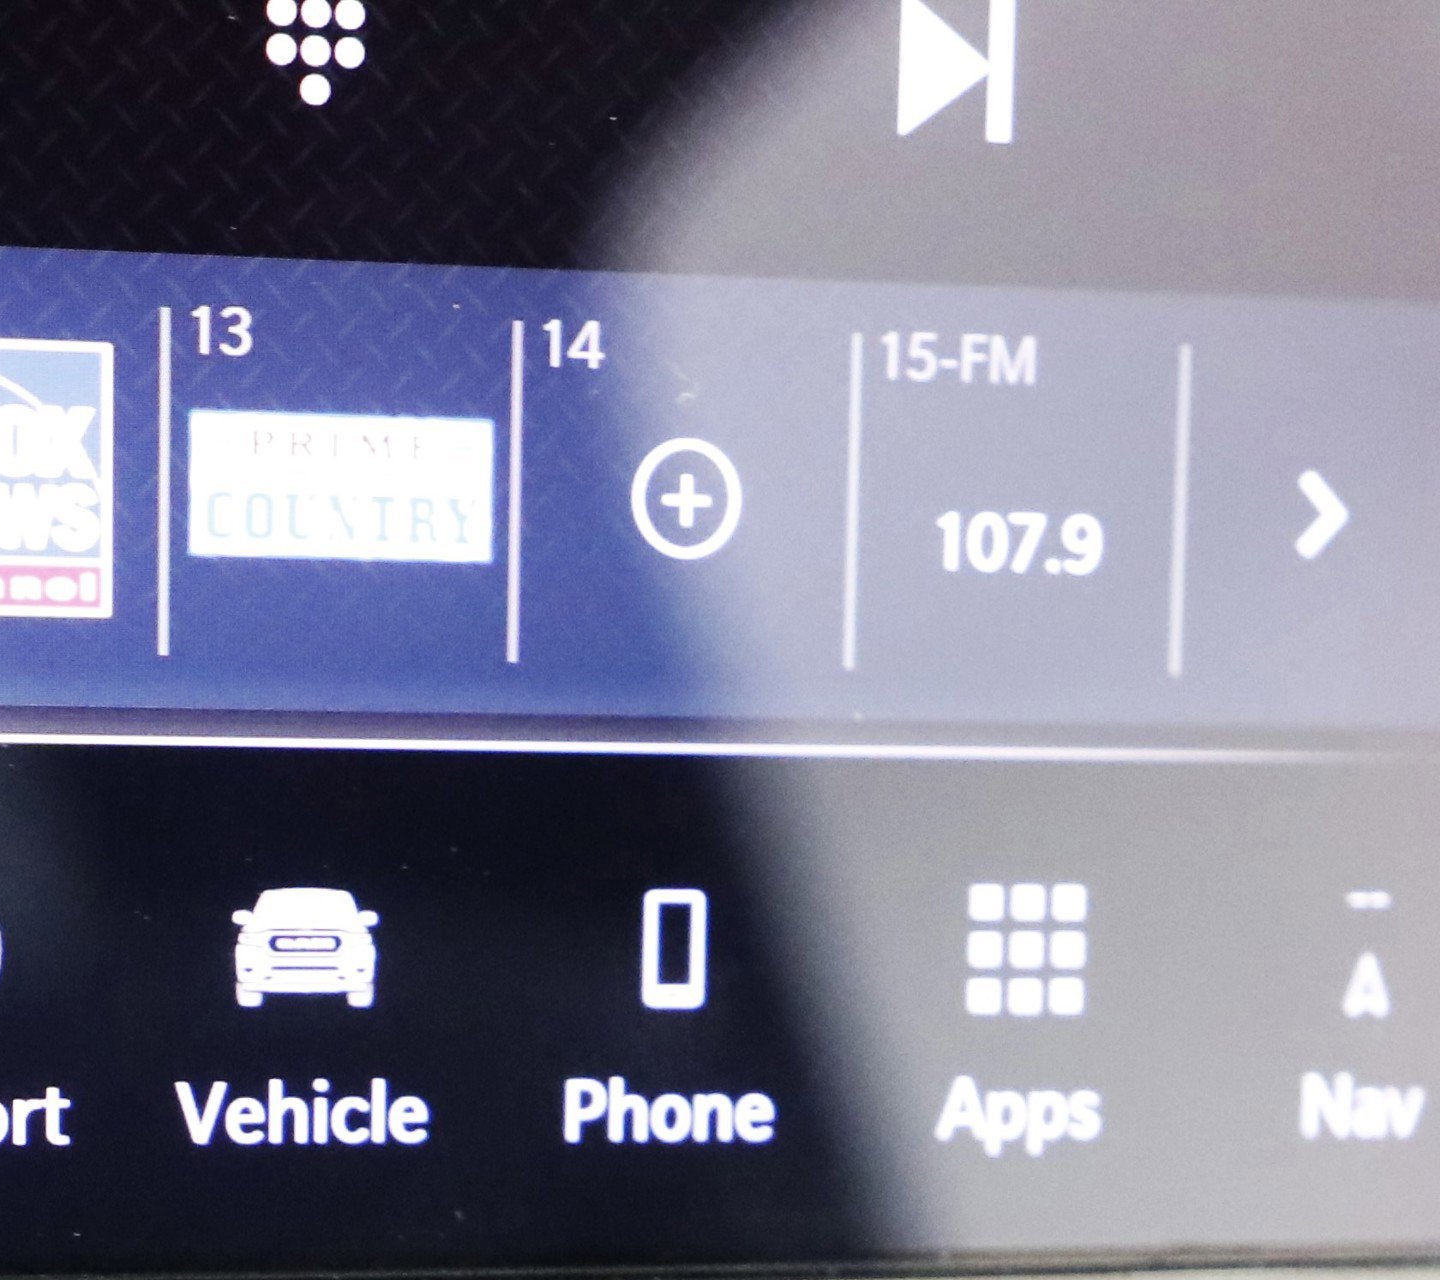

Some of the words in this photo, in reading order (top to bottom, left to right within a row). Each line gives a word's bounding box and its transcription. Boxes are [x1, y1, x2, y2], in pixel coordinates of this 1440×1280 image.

[191, 304, 255, 358] 13
[542, 318, 606, 370] 14
[880, 330, 1038, 387] 15-FM
[934, 509, 1105, 577] 107.9
[174, 1077, 431, 1147] Vehicle
[561, 1075, 777, 1144] Phone
[934, 1074, 1104, 1158] Apps
[1297, 1070, 1427, 1140] Nav
